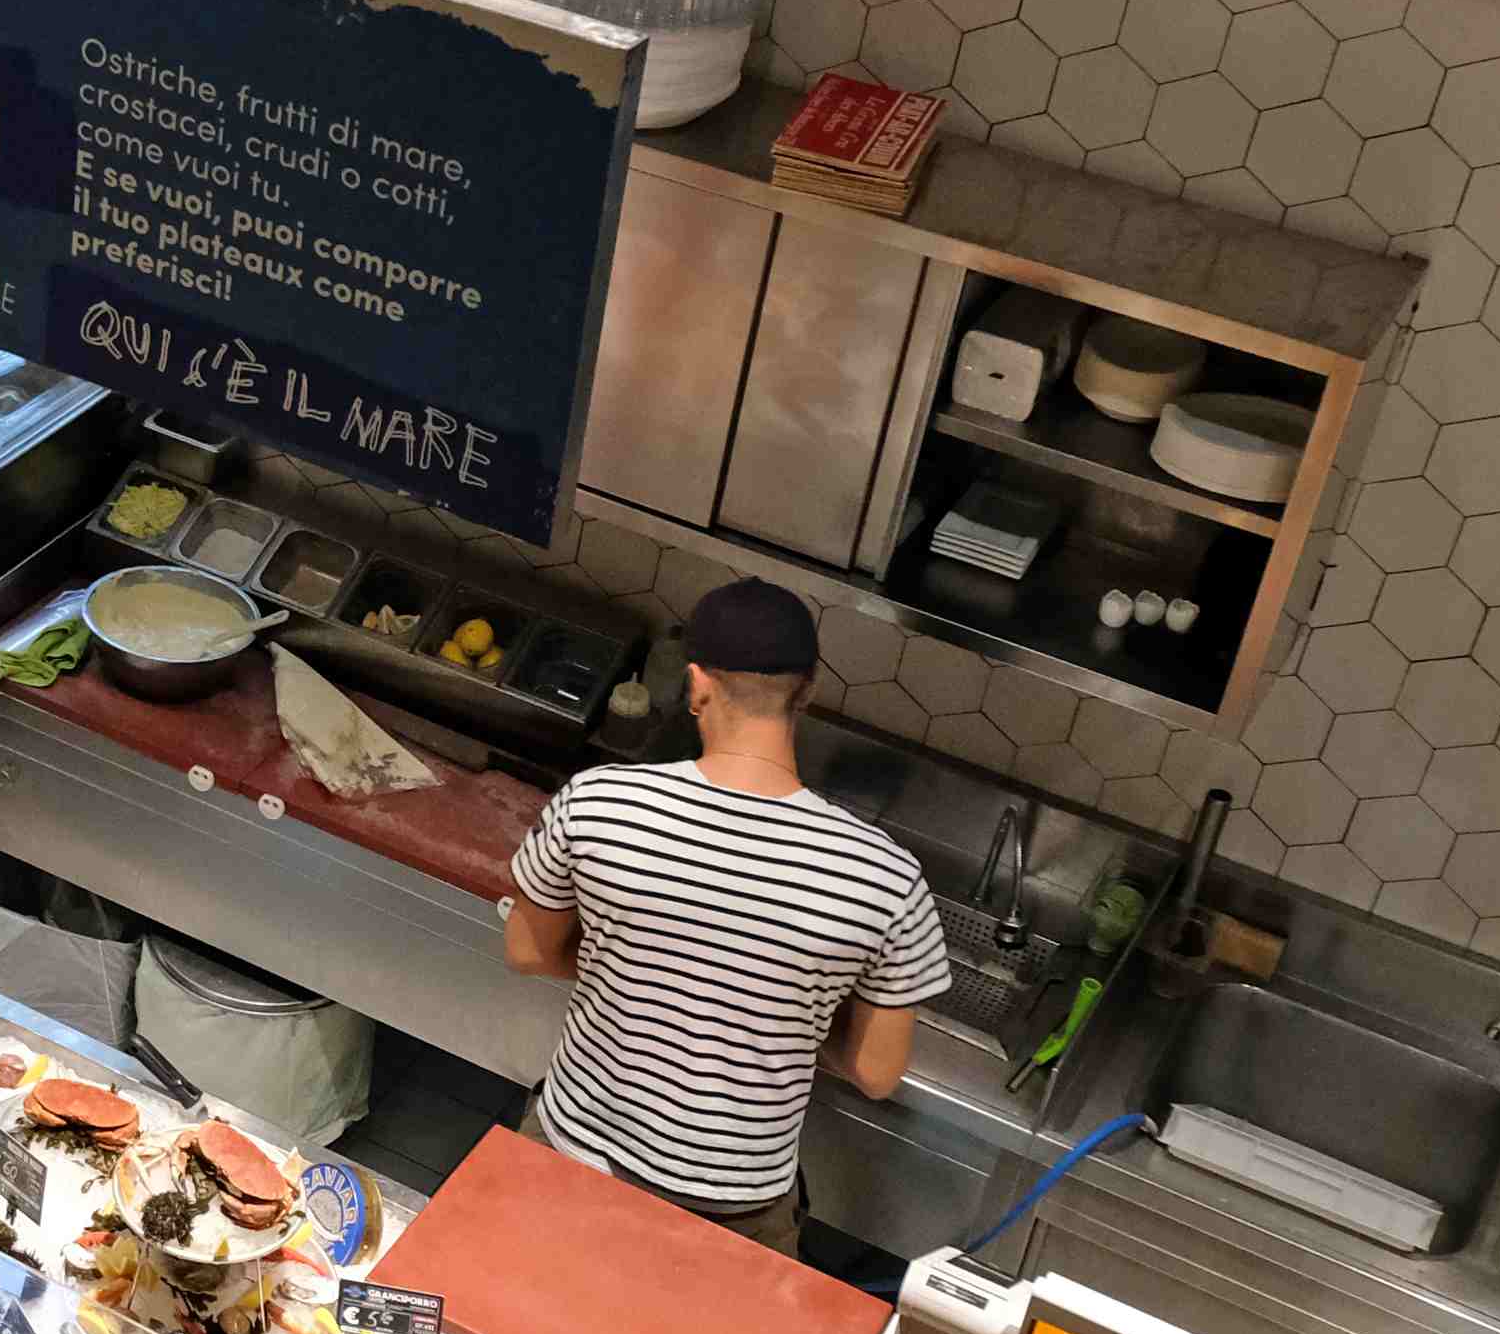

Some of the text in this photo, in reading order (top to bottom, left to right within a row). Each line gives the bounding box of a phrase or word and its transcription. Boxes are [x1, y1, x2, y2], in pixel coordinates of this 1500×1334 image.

[76, 120, 290, 209] come vuoi tu.
[78, 82, 455, 227] crostacei, crudi o cotti,
[80, 37, 472, 190] Ostriche, frutti di mare,
[71, 229, 233, 303] preferisci!
[72, 184, 407, 323] il tuo plateaux come
[75, 148, 483, 311] E se vuoi, puoi comporre
[79, 300, 172, 375] QUI
[282, 369, 332, 423] IL
[340, 395, 499, 489] MARE
